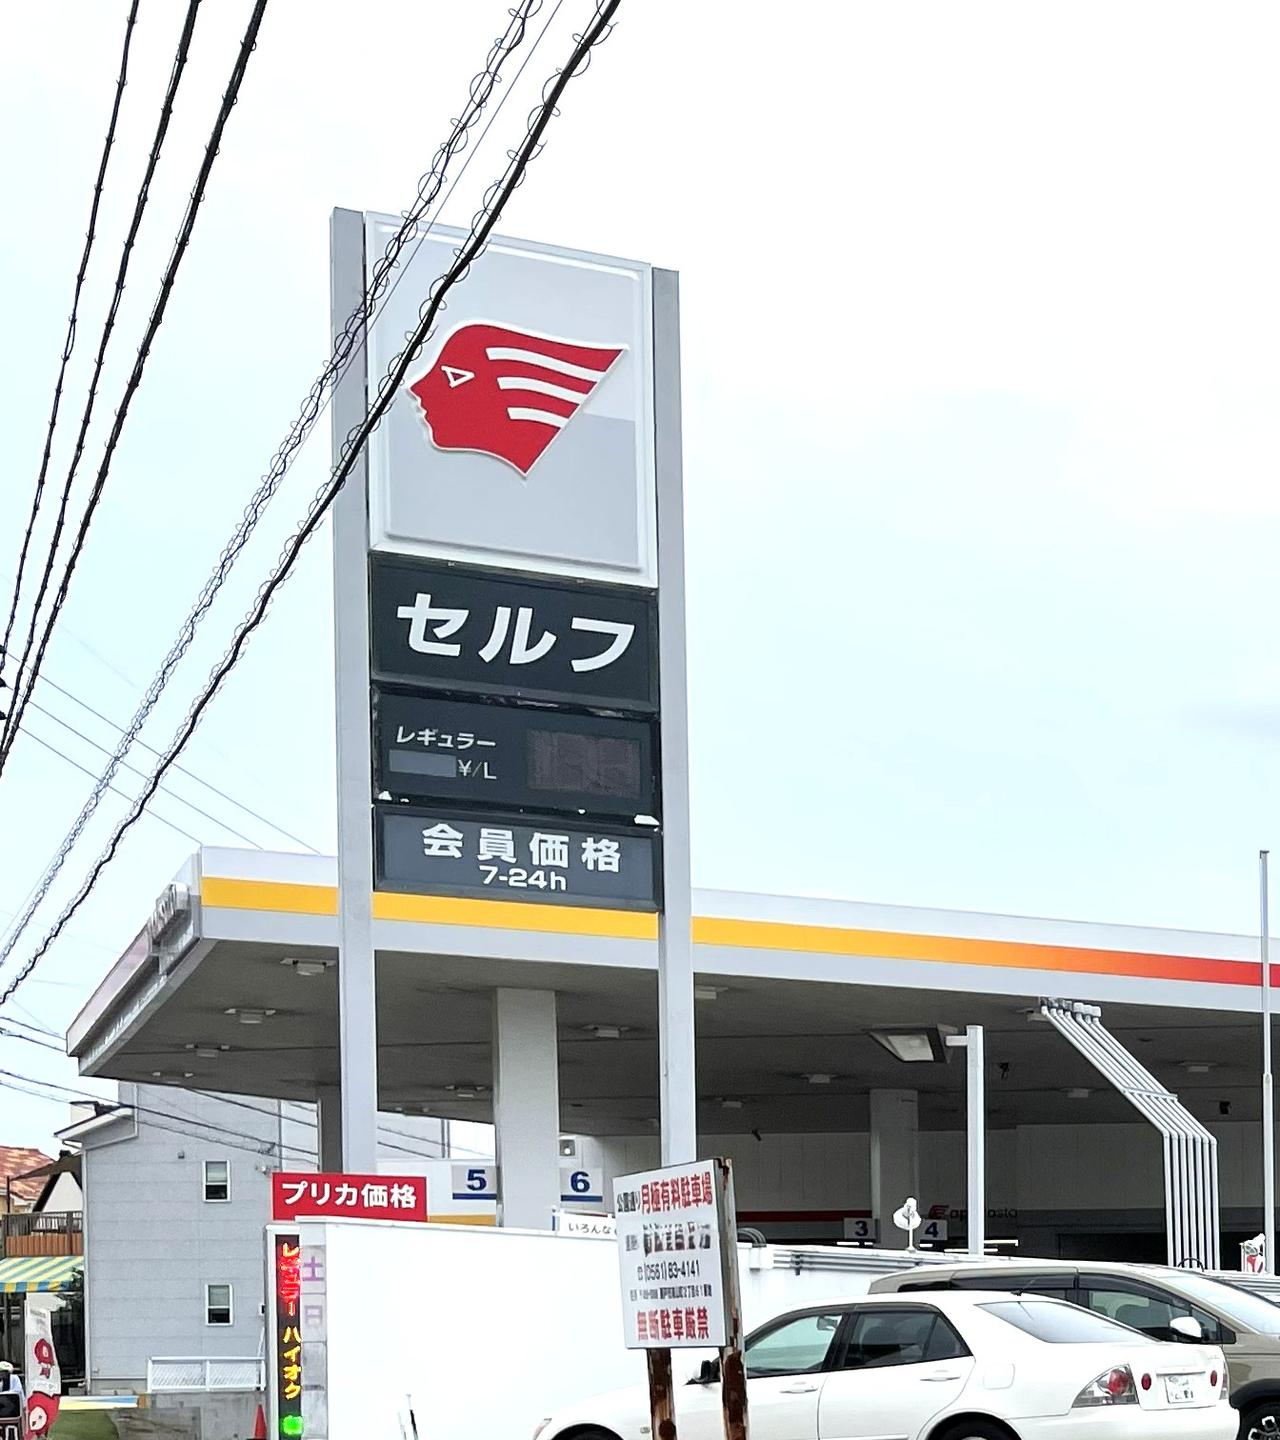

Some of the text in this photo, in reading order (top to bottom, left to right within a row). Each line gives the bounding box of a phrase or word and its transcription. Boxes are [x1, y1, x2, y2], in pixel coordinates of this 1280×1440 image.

[396, 592, 636, 673] セルフ
[395, 726, 497, 750] レギュラー
[421, 822, 622, 874] 会員価格
[478, 865, 568, 891] 7-24h
[466, 1168, 488, 1191] 5
[570, 1170, 591, 1193] 6
[281, 1179, 418, 1209] プリカ価格
[568, 1222, 618, 1236] いろんな
[854, 1219, 869, 1237] 3
[924, 1221, 939, 1238] 4
[282, 1326, 302, 1400] ハイオク
